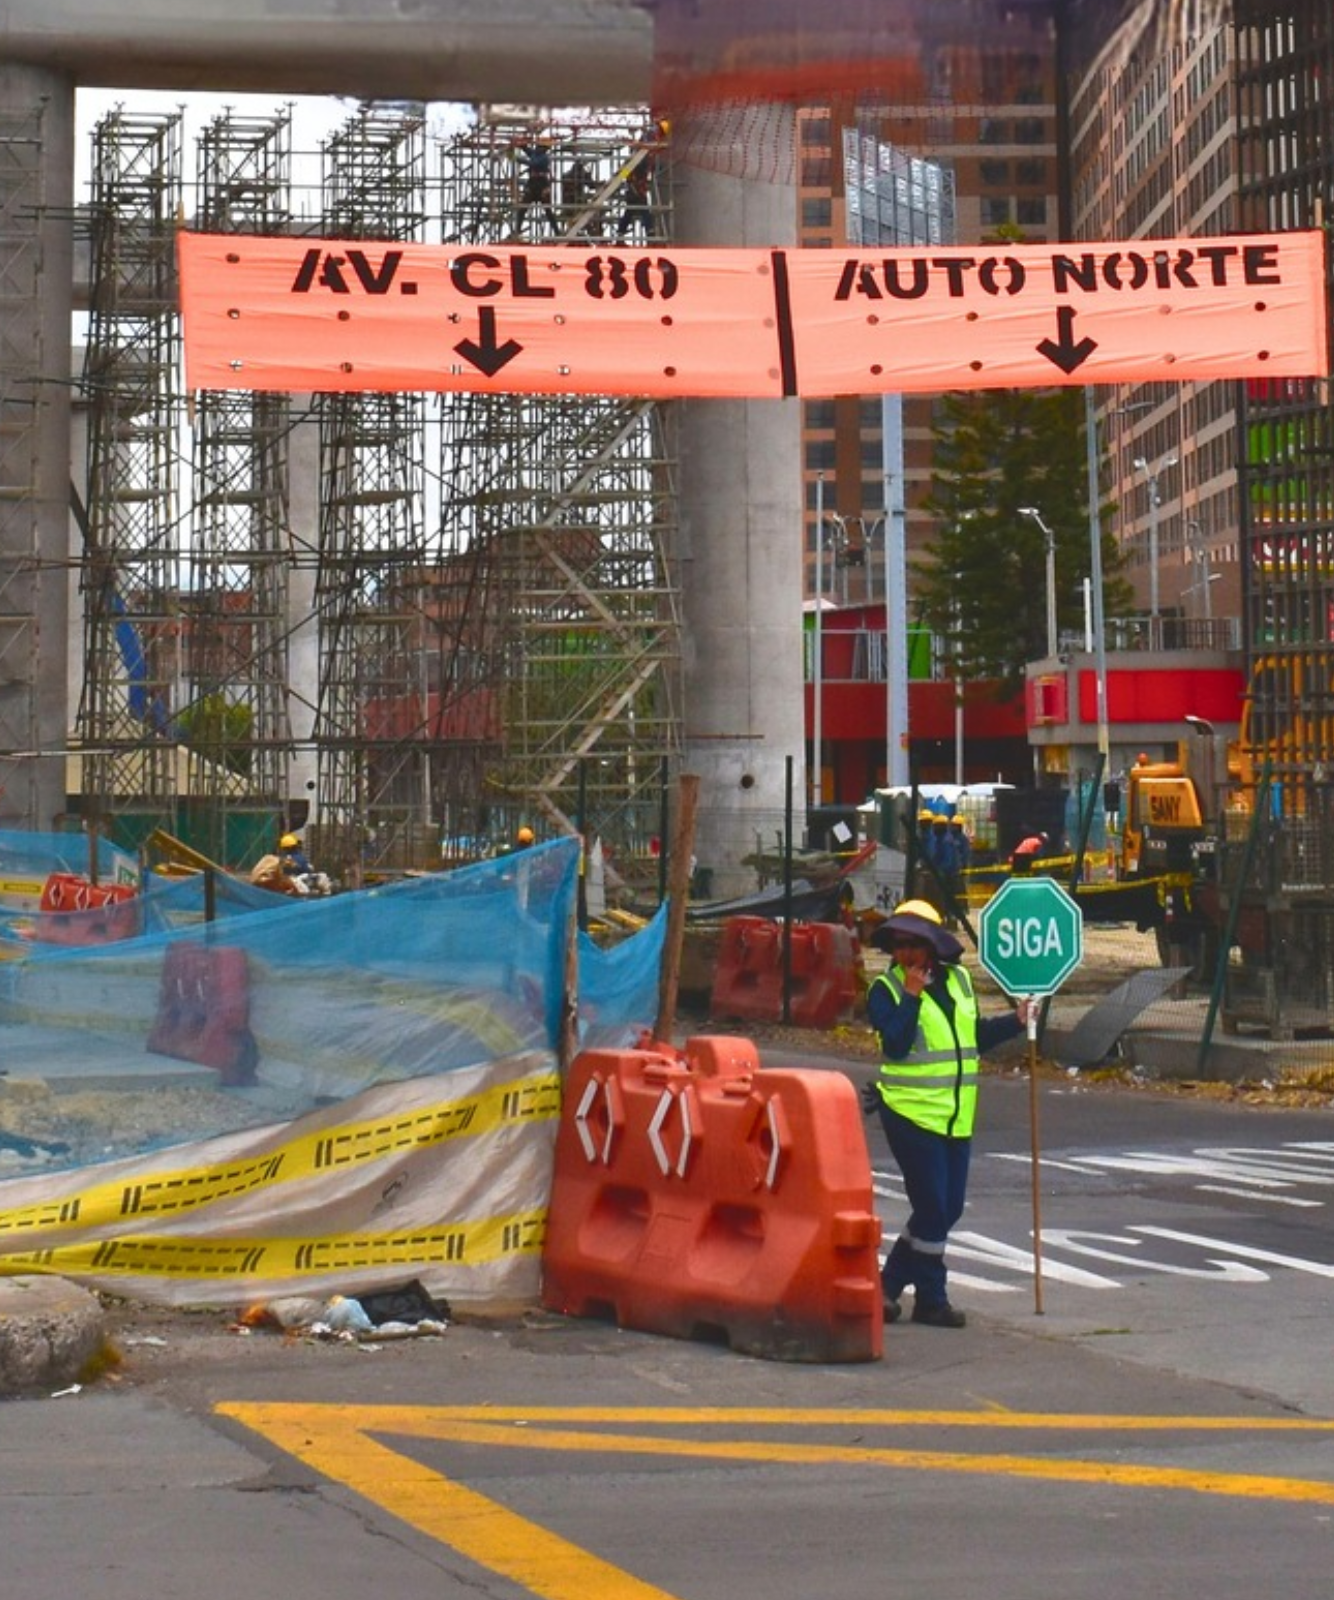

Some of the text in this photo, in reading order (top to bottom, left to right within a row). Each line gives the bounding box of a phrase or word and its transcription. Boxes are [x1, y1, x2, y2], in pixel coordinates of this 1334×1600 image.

[291, 248, 679, 300] AV. CL 80
[834, 244, 1281, 301] AUTO NORTE
[997, 917, 1063, 958] SIGA
